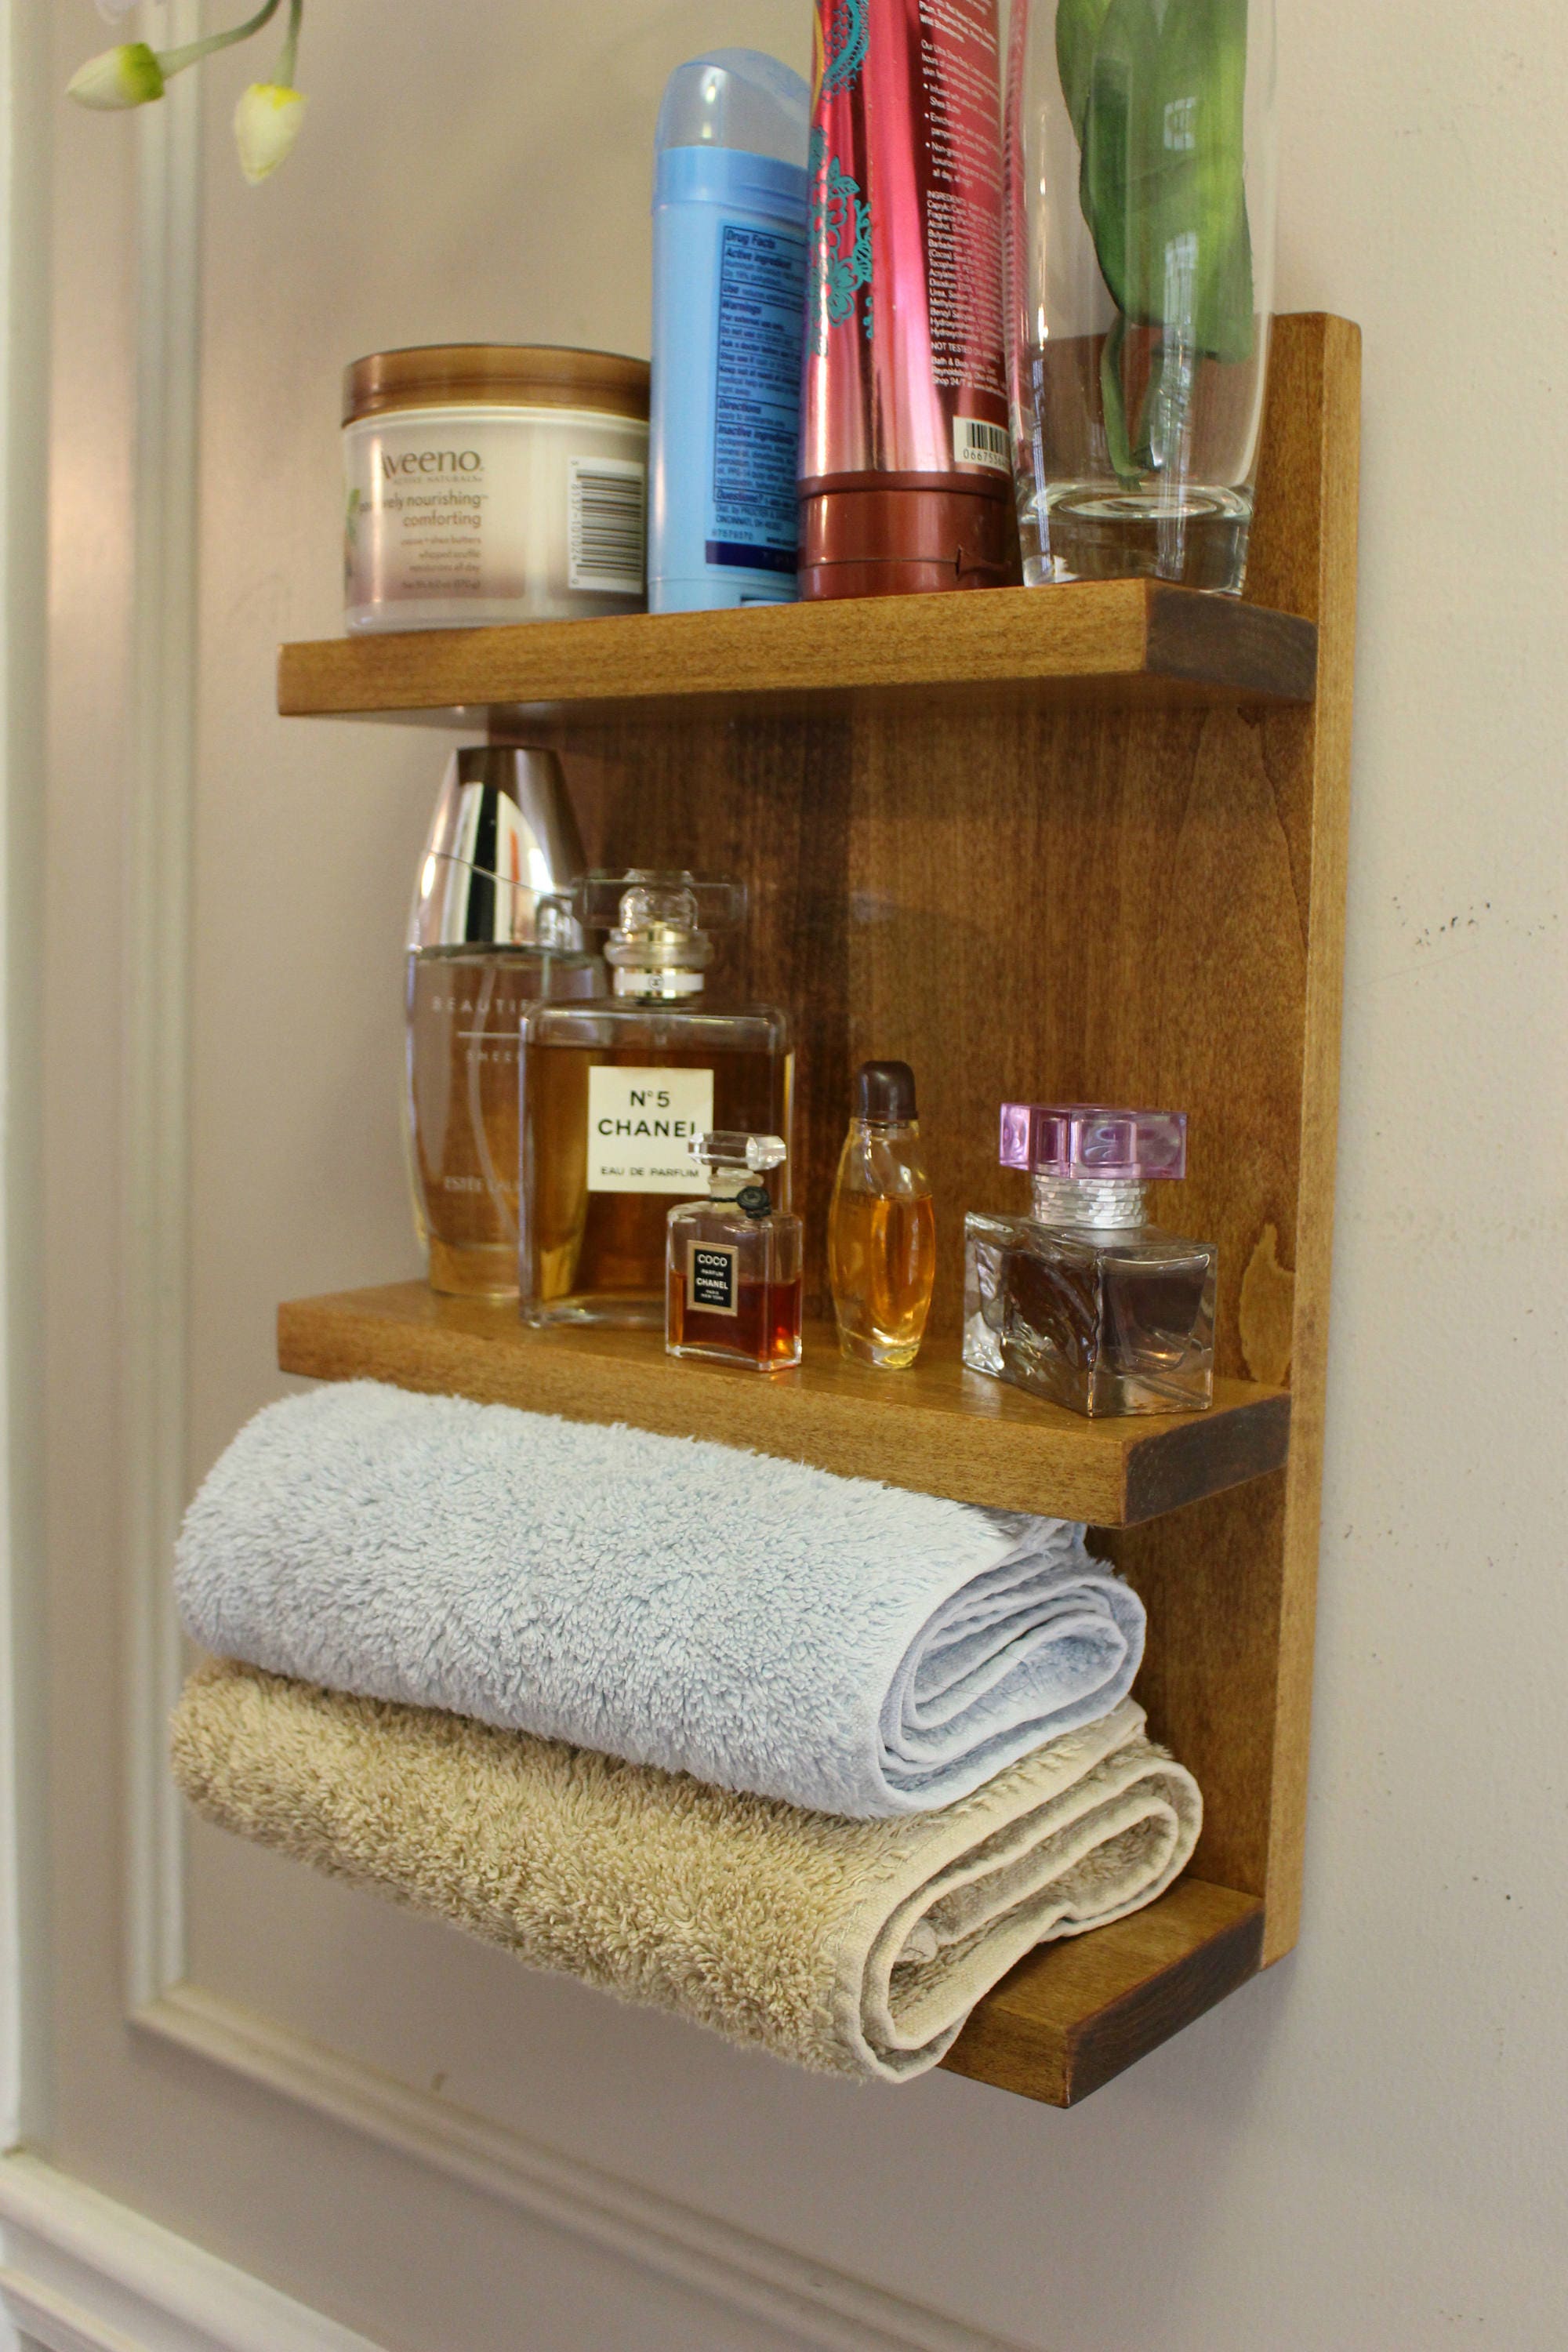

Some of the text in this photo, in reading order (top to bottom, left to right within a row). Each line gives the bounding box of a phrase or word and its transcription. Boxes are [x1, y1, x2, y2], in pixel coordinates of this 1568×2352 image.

[726, 229, 775, 249] Drug Facts
[727, 247, 752, 261] Active
[723, 283, 739, 294] Use
[722, 299, 761, 315] Warnings
[931, 341, 946, 351] NOT
[947, 342, 972, 355] TESTED
[932, 355, 947, 366] Bath
[934, 374, 949, 388] Shop
[718, 400, 761, 415] Directions
[718, 424, 753, 438] Inactive
[406, 488, 482, 509] nourishing
[717, 487, 764, 503] Questions?
[403, 510, 482, 529] comforting
[600, 1165, 700, 1178] EAU DE PARFUM
[697, 1254, 728, 1268] COCO
[695, 1277, 730, 1290] CHANEL
